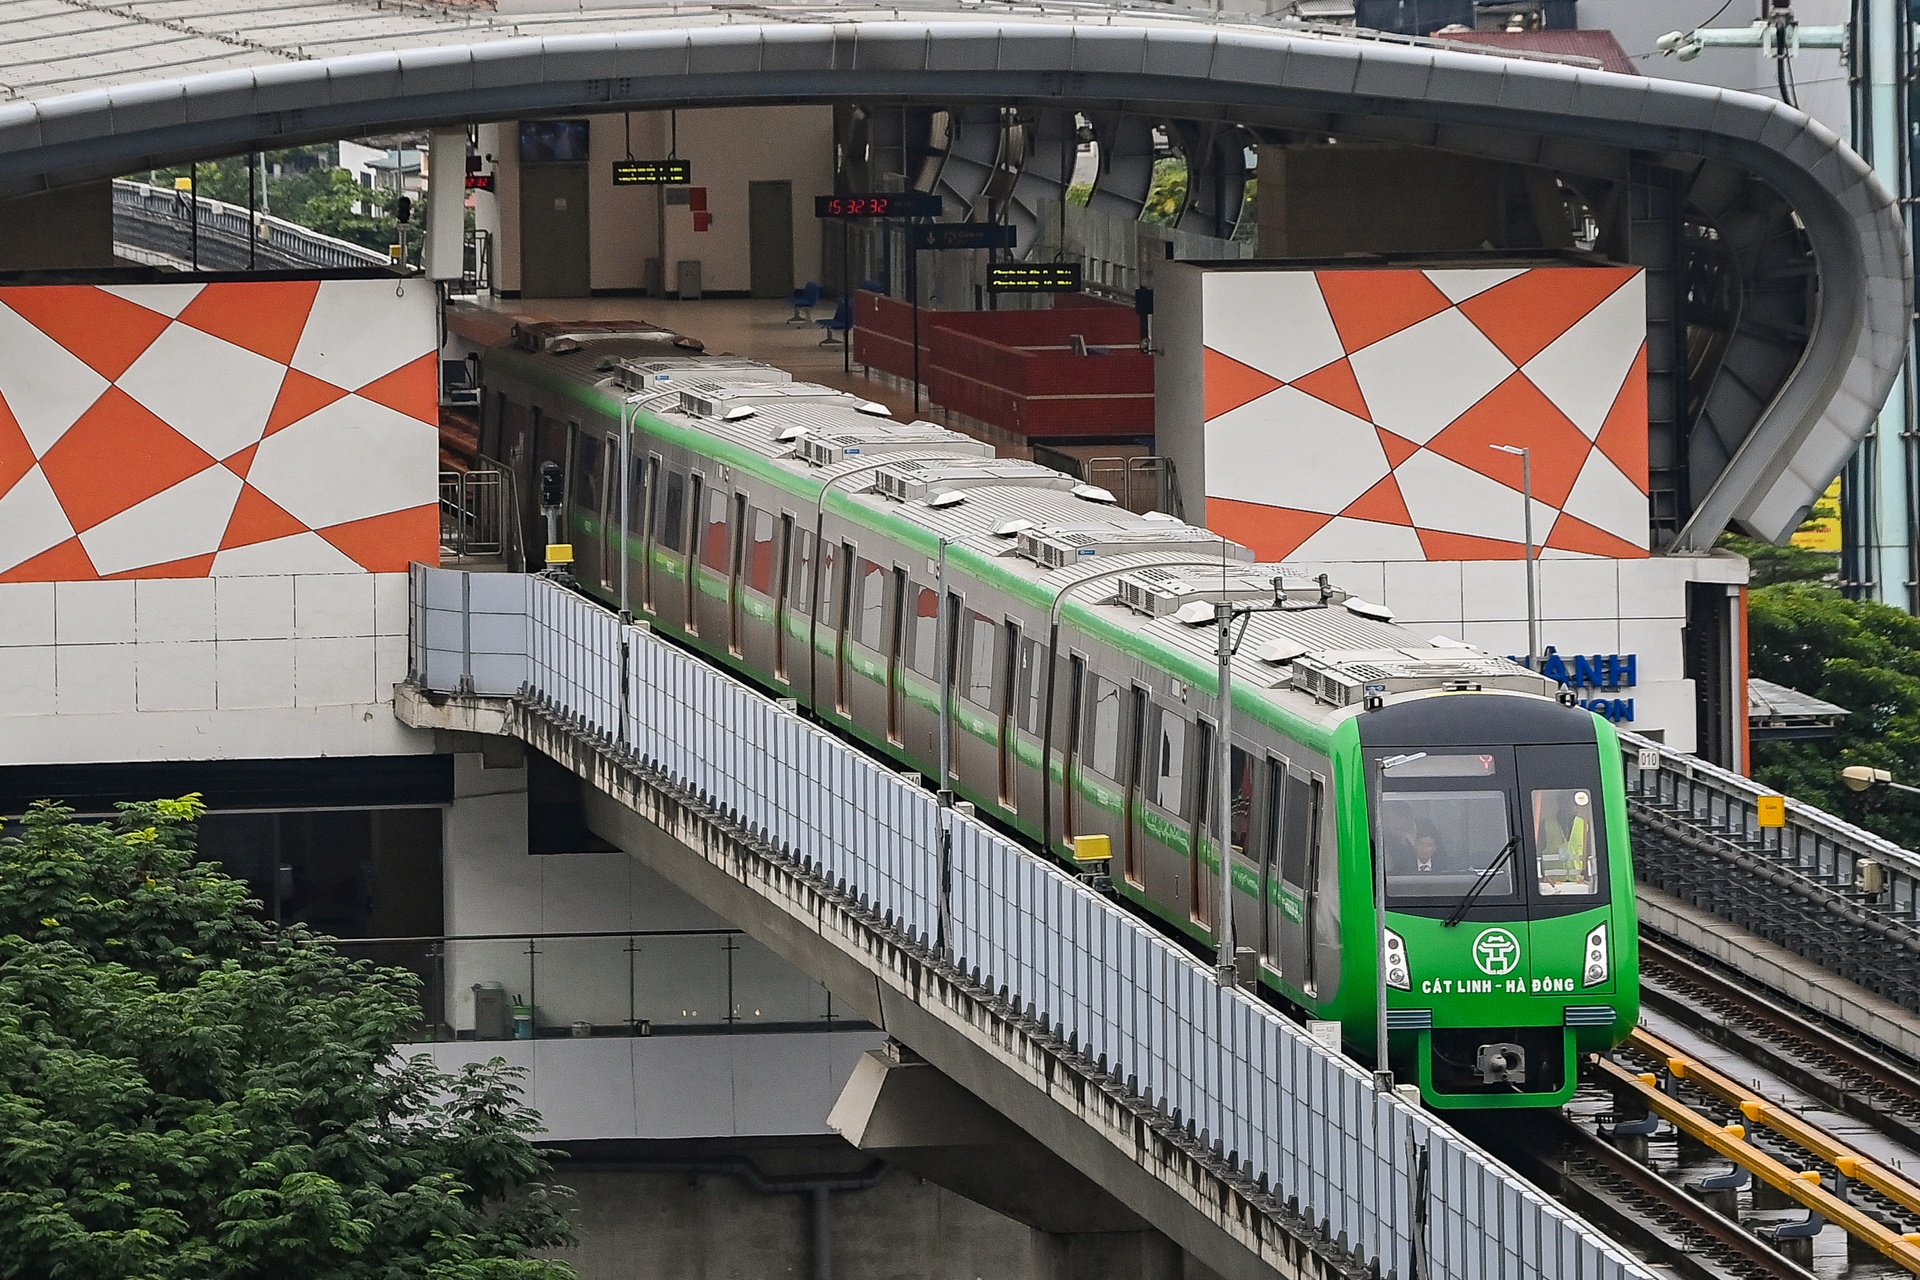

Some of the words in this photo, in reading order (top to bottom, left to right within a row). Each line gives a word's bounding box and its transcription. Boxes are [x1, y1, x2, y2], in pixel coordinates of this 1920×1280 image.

[870, 199, 888, 213] 32
[1641, 752, 1657, 766] 010
[1422, 978, 1452, 993] CÁT
[1458, 980, 1492, 993] LINH
[1506, 977, 1526, 992] HÀ
[1531, 976, 1574, 992] ĐÔNG
